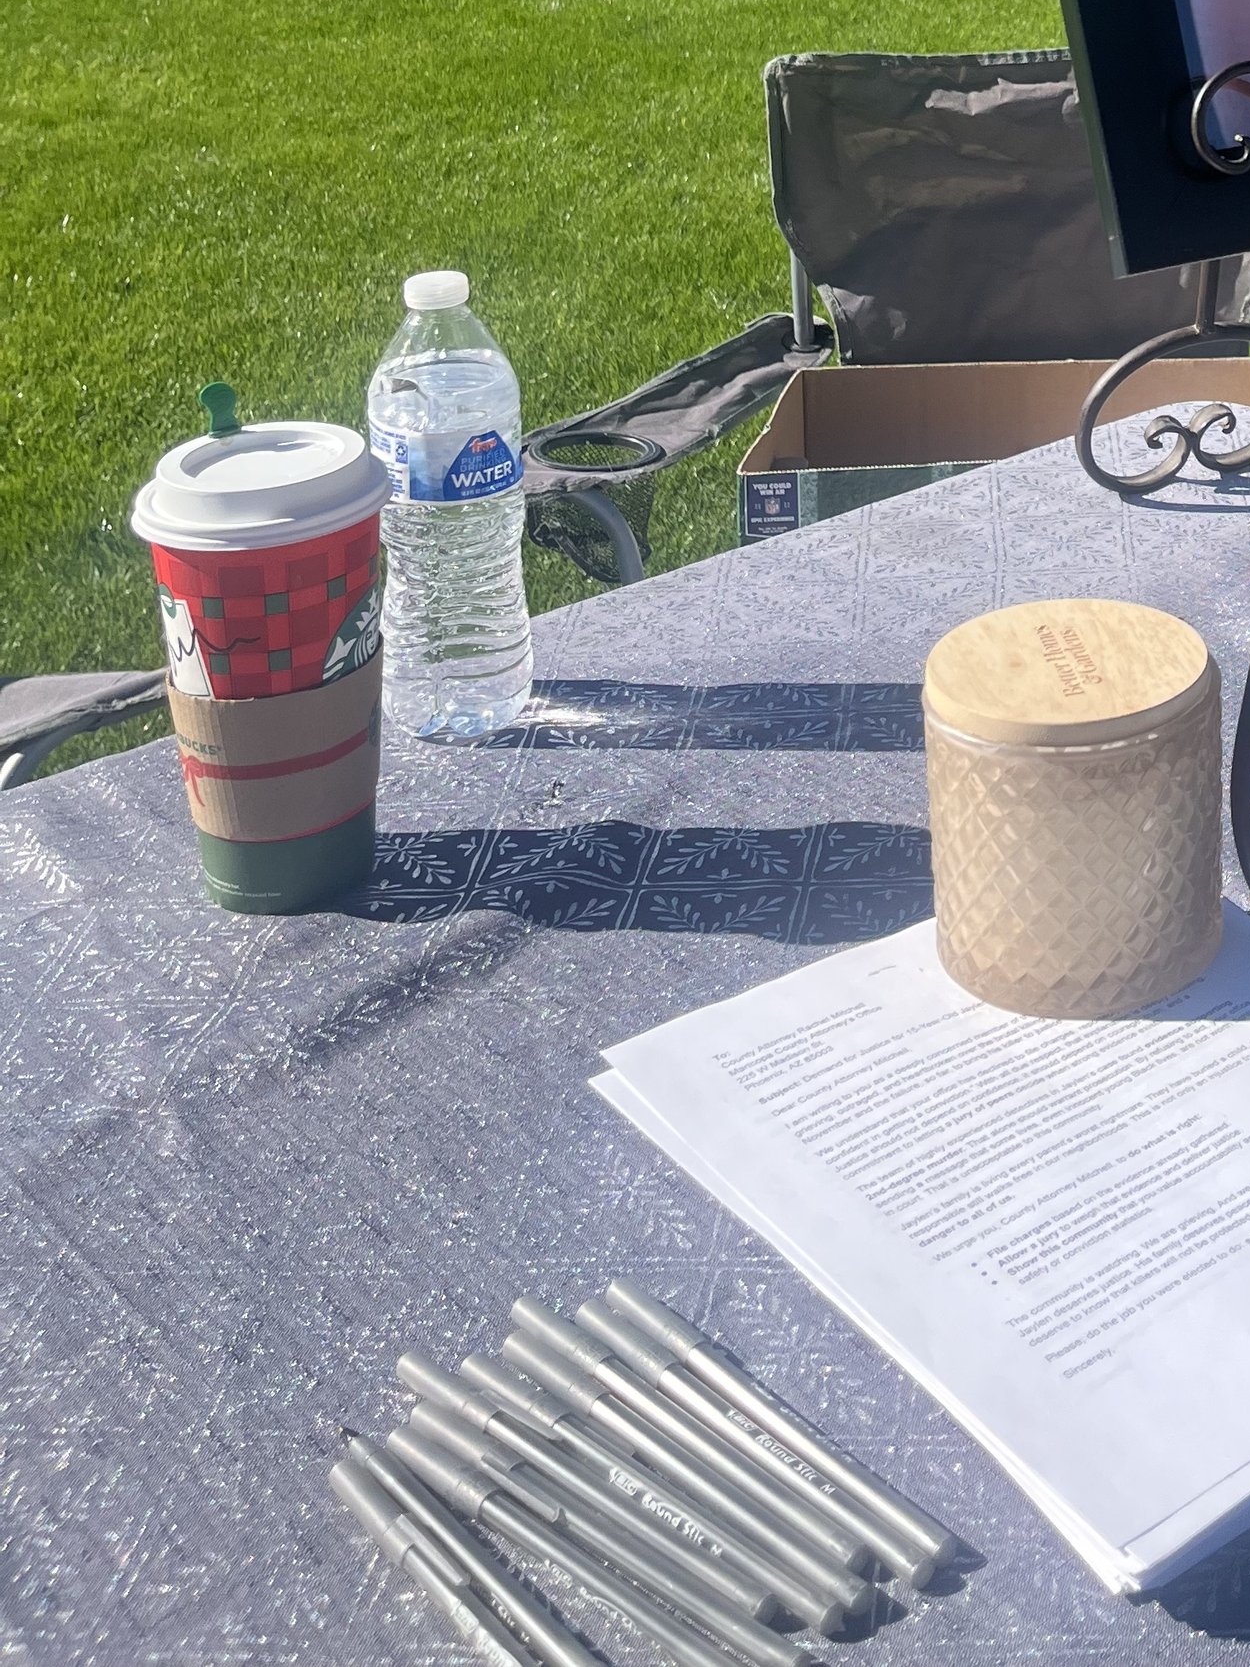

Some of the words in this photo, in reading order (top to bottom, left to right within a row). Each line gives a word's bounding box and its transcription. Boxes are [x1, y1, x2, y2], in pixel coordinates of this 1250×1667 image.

[451, 461, 513, 488] WATER
[460, 454, 507, 472] DRINKING
[461, 447, 505, 465] PURIFIED
[1034, 624, 1067, 663] Homes
[1059, 627, 1097, 674] Gardens
[1054, 663, 1085, 697] Better
[721, 1051, 758, 1068] County
[757, 1033, 798, 1051] Attorney
[798, 1017, 831, 1033] Rachel
[831, 1002, 866, 1019] Mitchell
[729, 1054, 774, 1075] Maricopa
[775, 1038, 811, 1054] County
[809, 1018, 856, 1039] Attorney's
[856, 1006, 883, 1018] Office
[770, 1047, 811, 1067] Madison
[759, 1082, 802, 1104] Subject:
[803, 1061, 844, 1082] Demand
[859, 1040, 892, 1055] Justice
[772, 1103, 797, 1116] Dear
[797, 1085, 834, 1103] County
[833, 1066, 874, 1085] Attorney
[954, 1237, 978, 1251] urge
[1000, 1205, 1038, 1225] County
[1036, 1182, 1079, 1205] Attorney
[1142, 1135, 1167, 1150] what
[987, 1245, 1008, 1258] File
[1010, 1221, 1052, 1246] charges
[1052, 1203, 1083, 1222] based
[1097, 1187, 1113, 1197] the
[1115, 1165, 1155, 1189] evidence
[1156, 1146, 1191, 1166] already
[997, 1248, 1029, 1267] Allow
[1037, 1231, 1061, 1246] jury
[1072, 1207, 1100, 1225] weigh
[1101, 1196, 1121, 1209] that
[1122, 1175, 1162, 1198] evidence
[1164, 1163, 1181, 1175] and
[1180, 1147, 1212, 1165] deliver
[1007, 1257, 1039, 1276] Show
[1040, 1244, 1061, 1258] this
[1062, 1212, 1120, 1245] community
[1119, 1201, 1138, 1213] that
[1139, 1191, 1157, 1204] you
[1157, 1177, 1183, 1192] value
[1184, 1143, 1245, 1178] accountability
[918, 1226, 957, 1248] danger
[971, 1209, 985, 1219] all
[1019, 1266, 1051, 1285] safety
[1063, 1230, 1111, 1259] conviction
[1007, 1314, 1030, 1327] The
[1031, 1282, 1086, 1315] community
[1162, 1228, 1178, 1239] are
[1216, 1194, 1237, 1207] And
[1018, 1316, 1053, 1337] Jaylen
[1052, 1288, 1100, 1317] deserves
[1134, 1257, 1153, 1269] His
[1152, 1240, 1184, 1258] family
[1182, 1216, 1225, 1241] deserves
[1029, 1320, 1071, 1347] deserve
[1082, 1297, 1111, 1315] know
[1111, 1284, 1132, 1298] that
[1162, 1256, 1178, 1268] will
[1179, 1247, 1195, 1258] not
[1101, 1318, 1119, 1330] the
[1118, 1306, 1137, 1321] job
[1137, 1295, 1156, 1310] you
[1157, 1280, 1182, 1296] were
[1183, 1258, 1216, 1281] elected
[1063, 1347, 1116, 1379] Sincerely,
[756, 1434, 799, 1463] Round
[793, 1461, 817, 1481] Stic
[820, 1483, 837, 1495] M
[642, 1493, 681, 1528] Round
[683, 1515, 705, 1544] Stic
[709, 1543, 723, 1558] M
